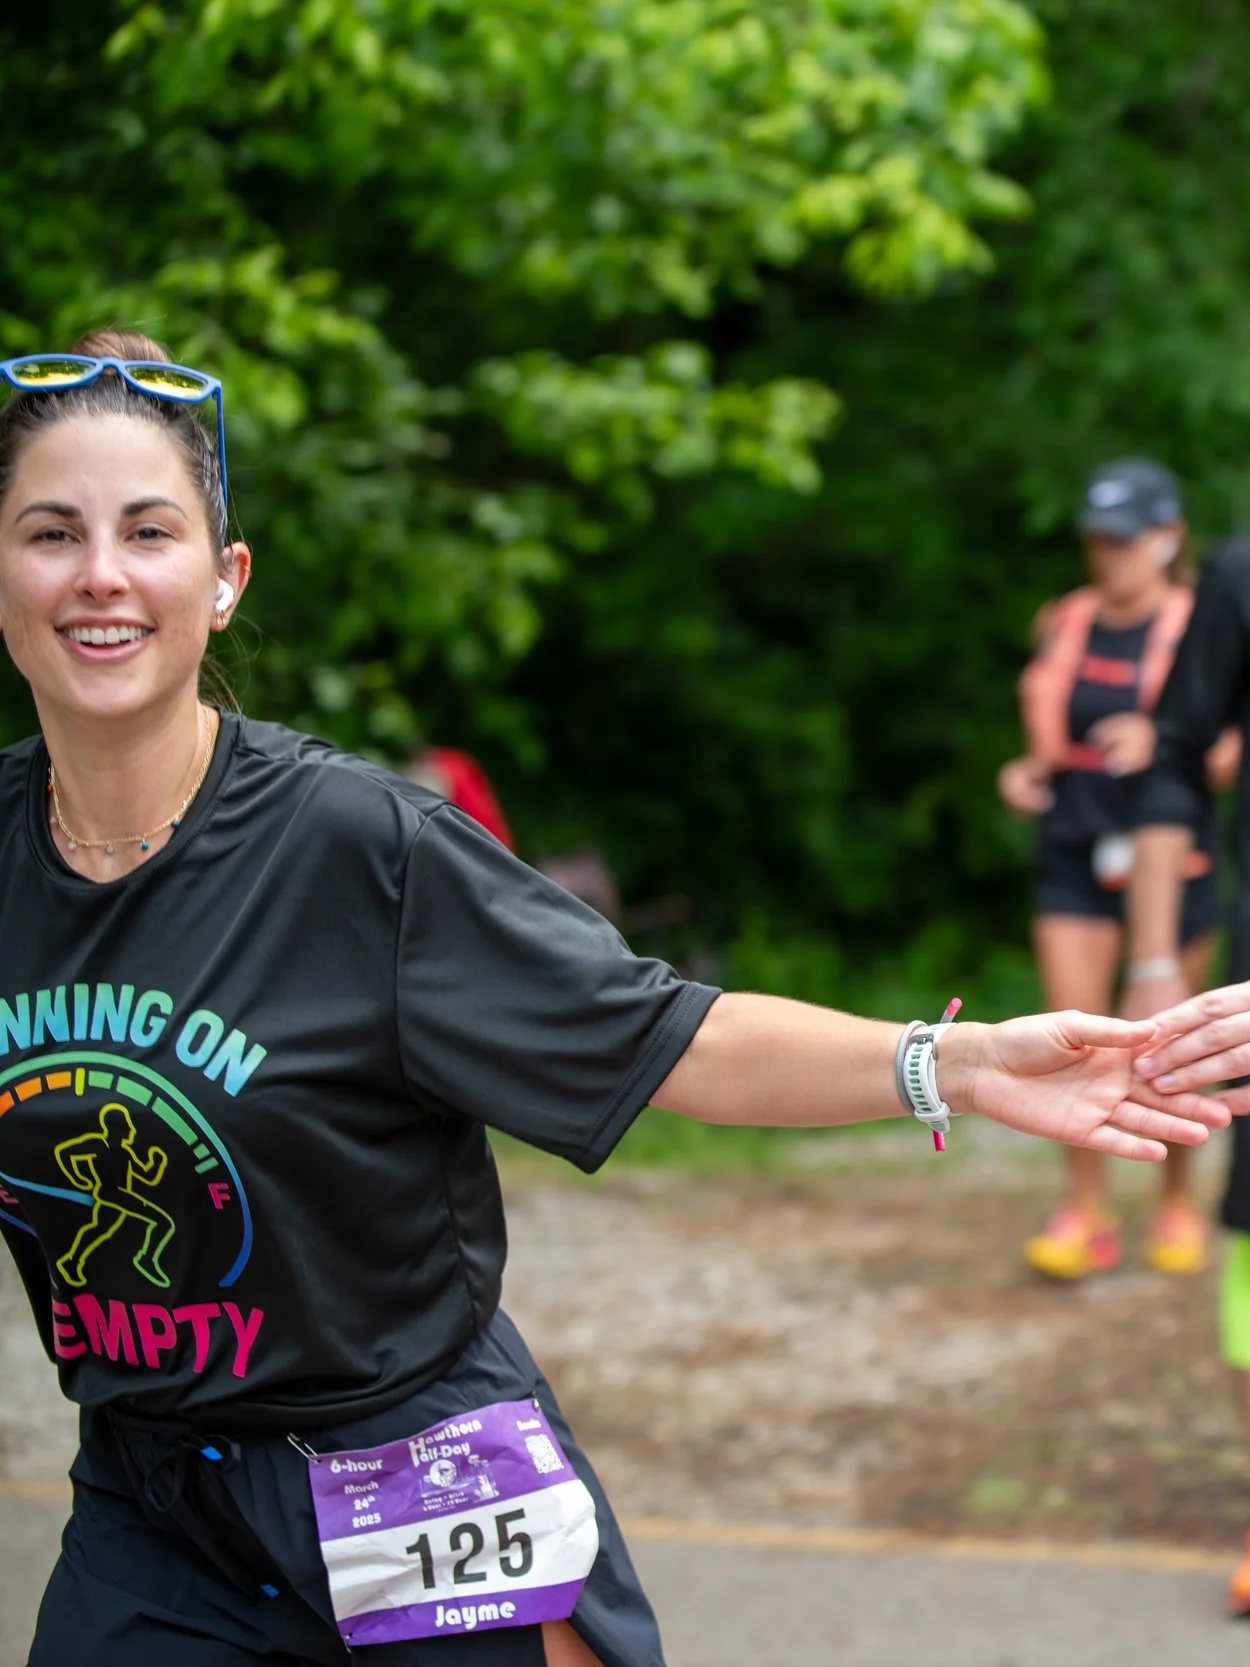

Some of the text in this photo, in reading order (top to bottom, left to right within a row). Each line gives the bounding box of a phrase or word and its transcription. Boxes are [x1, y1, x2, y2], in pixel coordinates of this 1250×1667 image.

[175, 1009, 267, 1097] ON
[208, 1182, 230, 1211] F
[52, 1293, 263, 1378] EMPTY
[408, 1420, 482, 1453] Hawthorn
[330, 1459, 383, 1474] 6-hour
[344, 1481, 379, 1495] March
[353, 1495, 376, 1511] 24th
[352, 1512, 382, 1528] 2025
[405, 1508, 533, 1590] 125
[435, 1601, 516, 1629] Jayme
